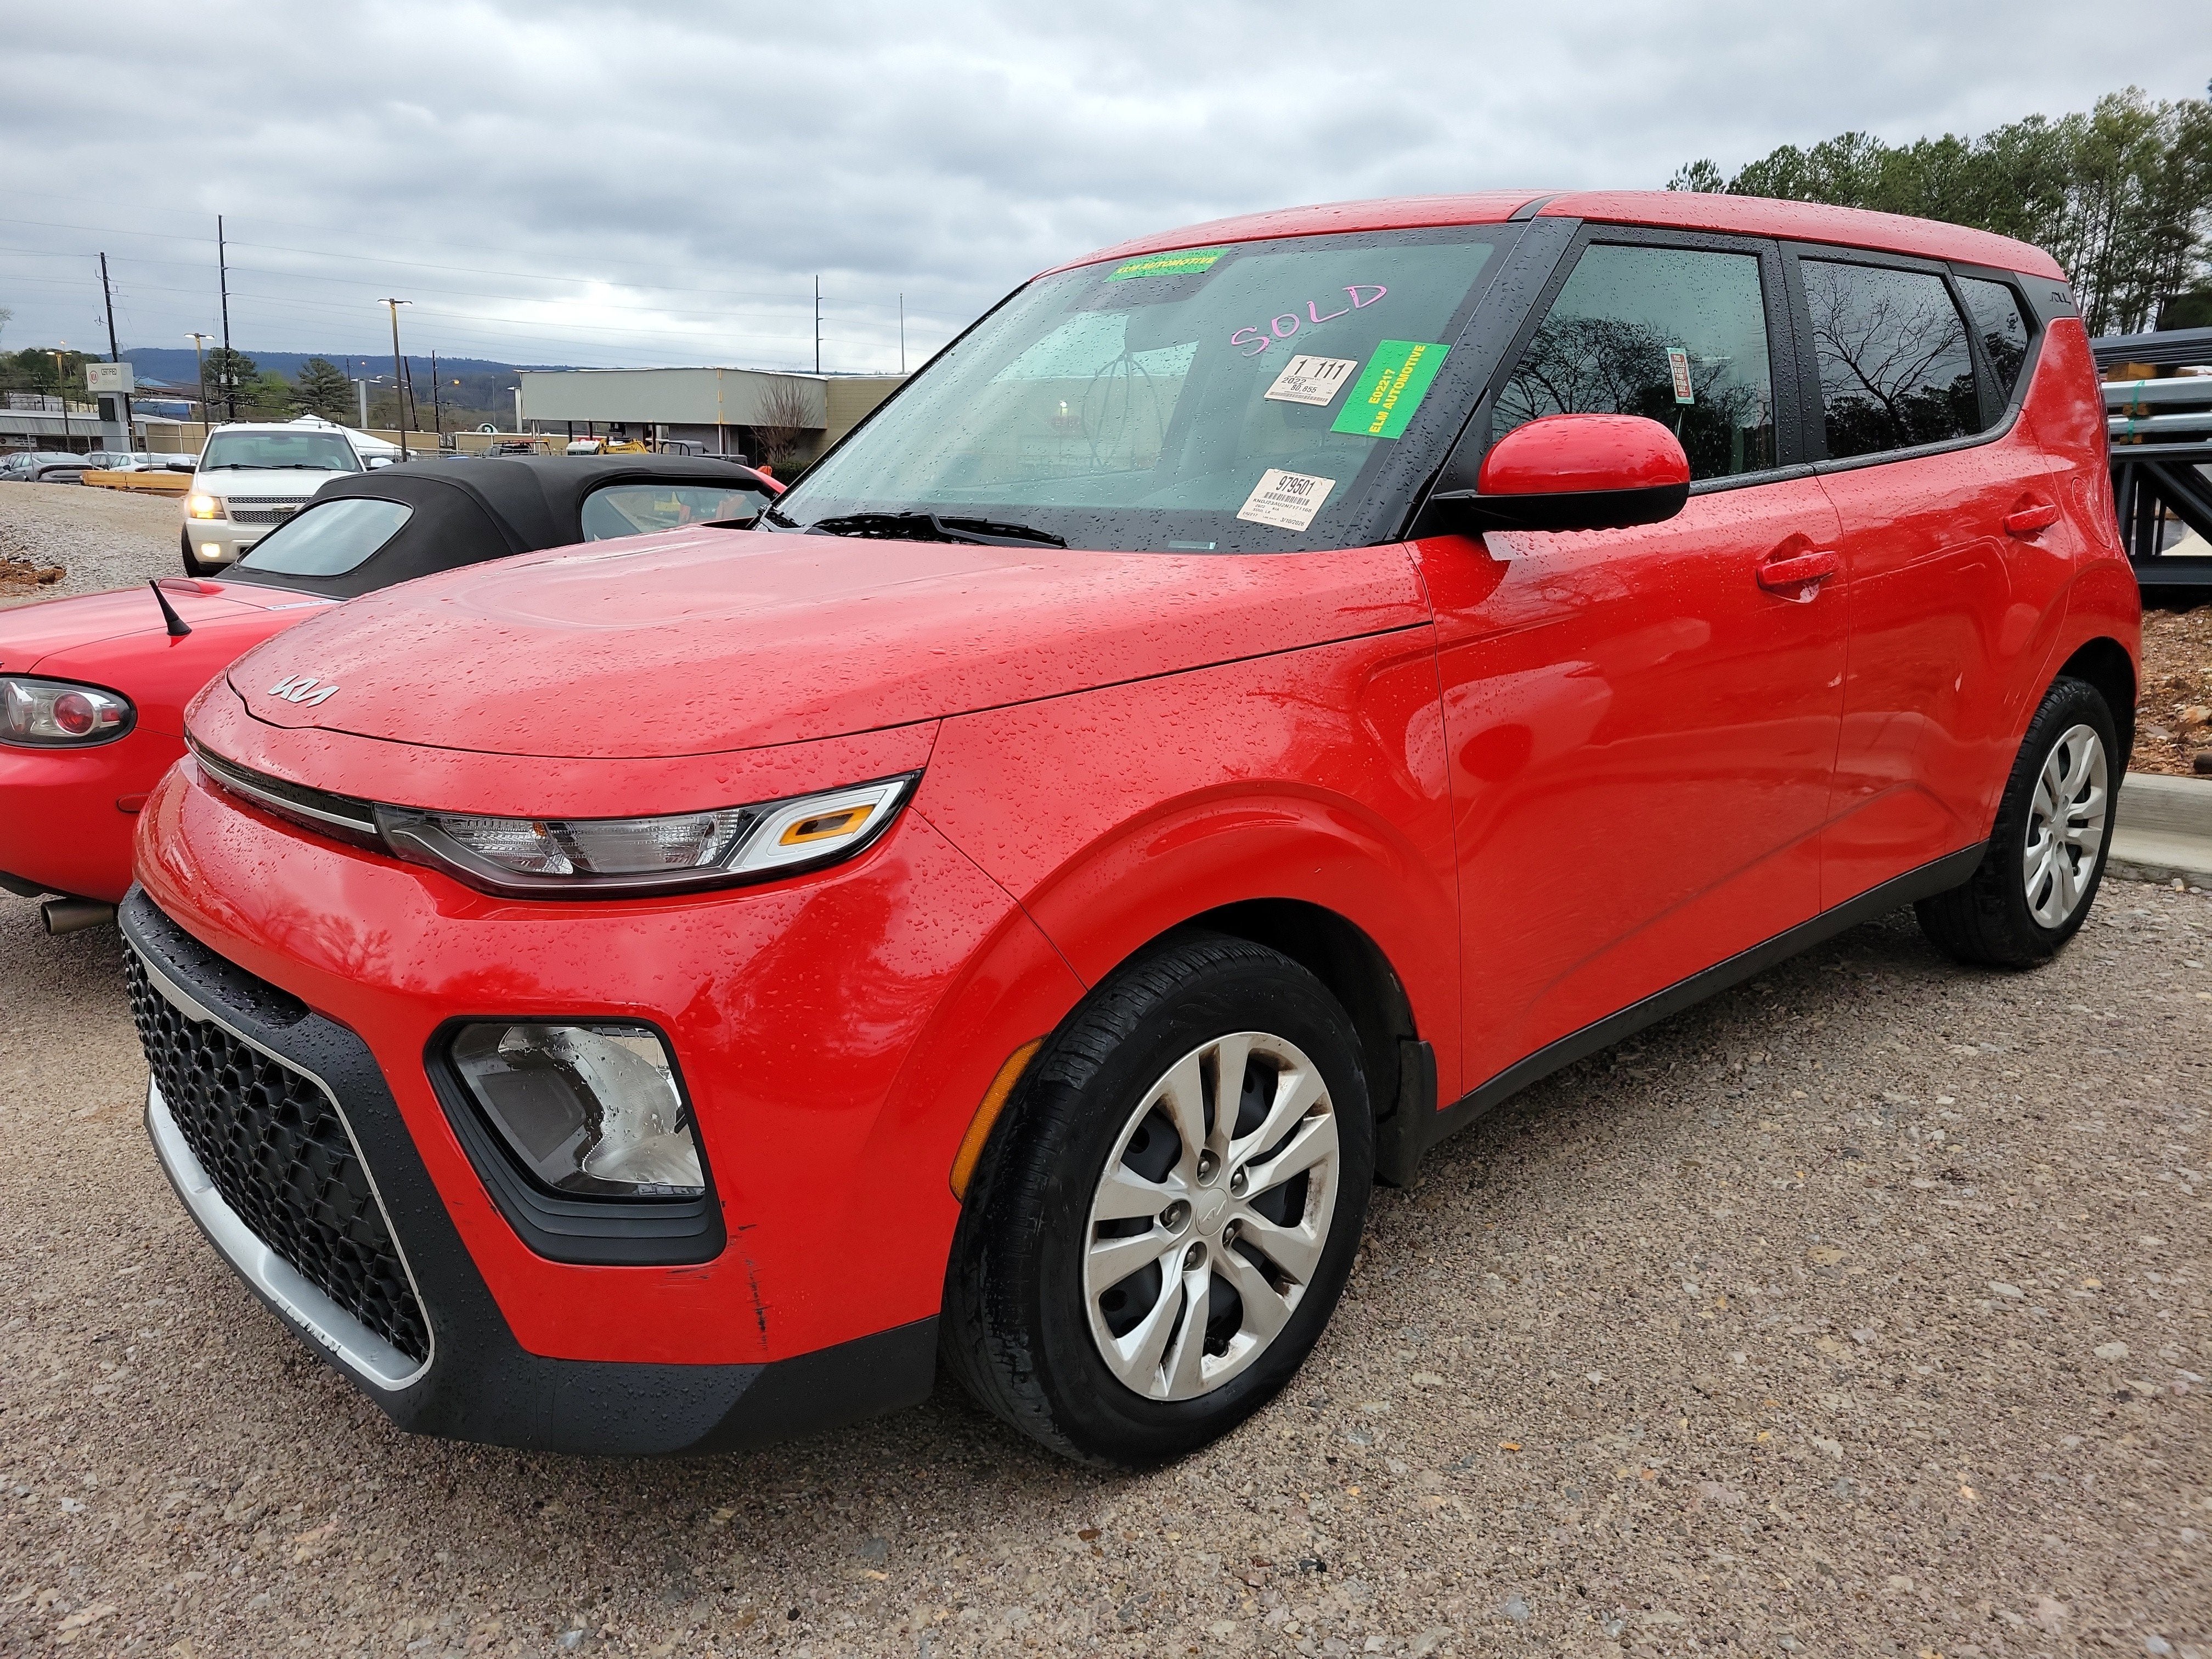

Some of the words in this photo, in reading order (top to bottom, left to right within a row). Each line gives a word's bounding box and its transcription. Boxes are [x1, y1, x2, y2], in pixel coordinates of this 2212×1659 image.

[1142, 257, 1218, 269] AUTOMOTIVE
[1231, 285, 1387, 357] SOLD
[1294, 358, 1308, 375] 1
[1314, 360, 1346, 380] 111
[1281, 377, 1307, 385] 2022
[1290, 384, 1318, 393] 80,855
[1368, 369, 1396, 404] E02217
[1368, 411, 1389, 433] ELM
[1382, 345, 1426, 410] AUTOMOTIVE
[1276, 475, 1316, 496] 979501
[1253, 498, 1312, 513] KNDJ23AU2N7171168
[1280, 517, 1305, 527] 3/10/2026
[267, 674, 340, 708] KIA
